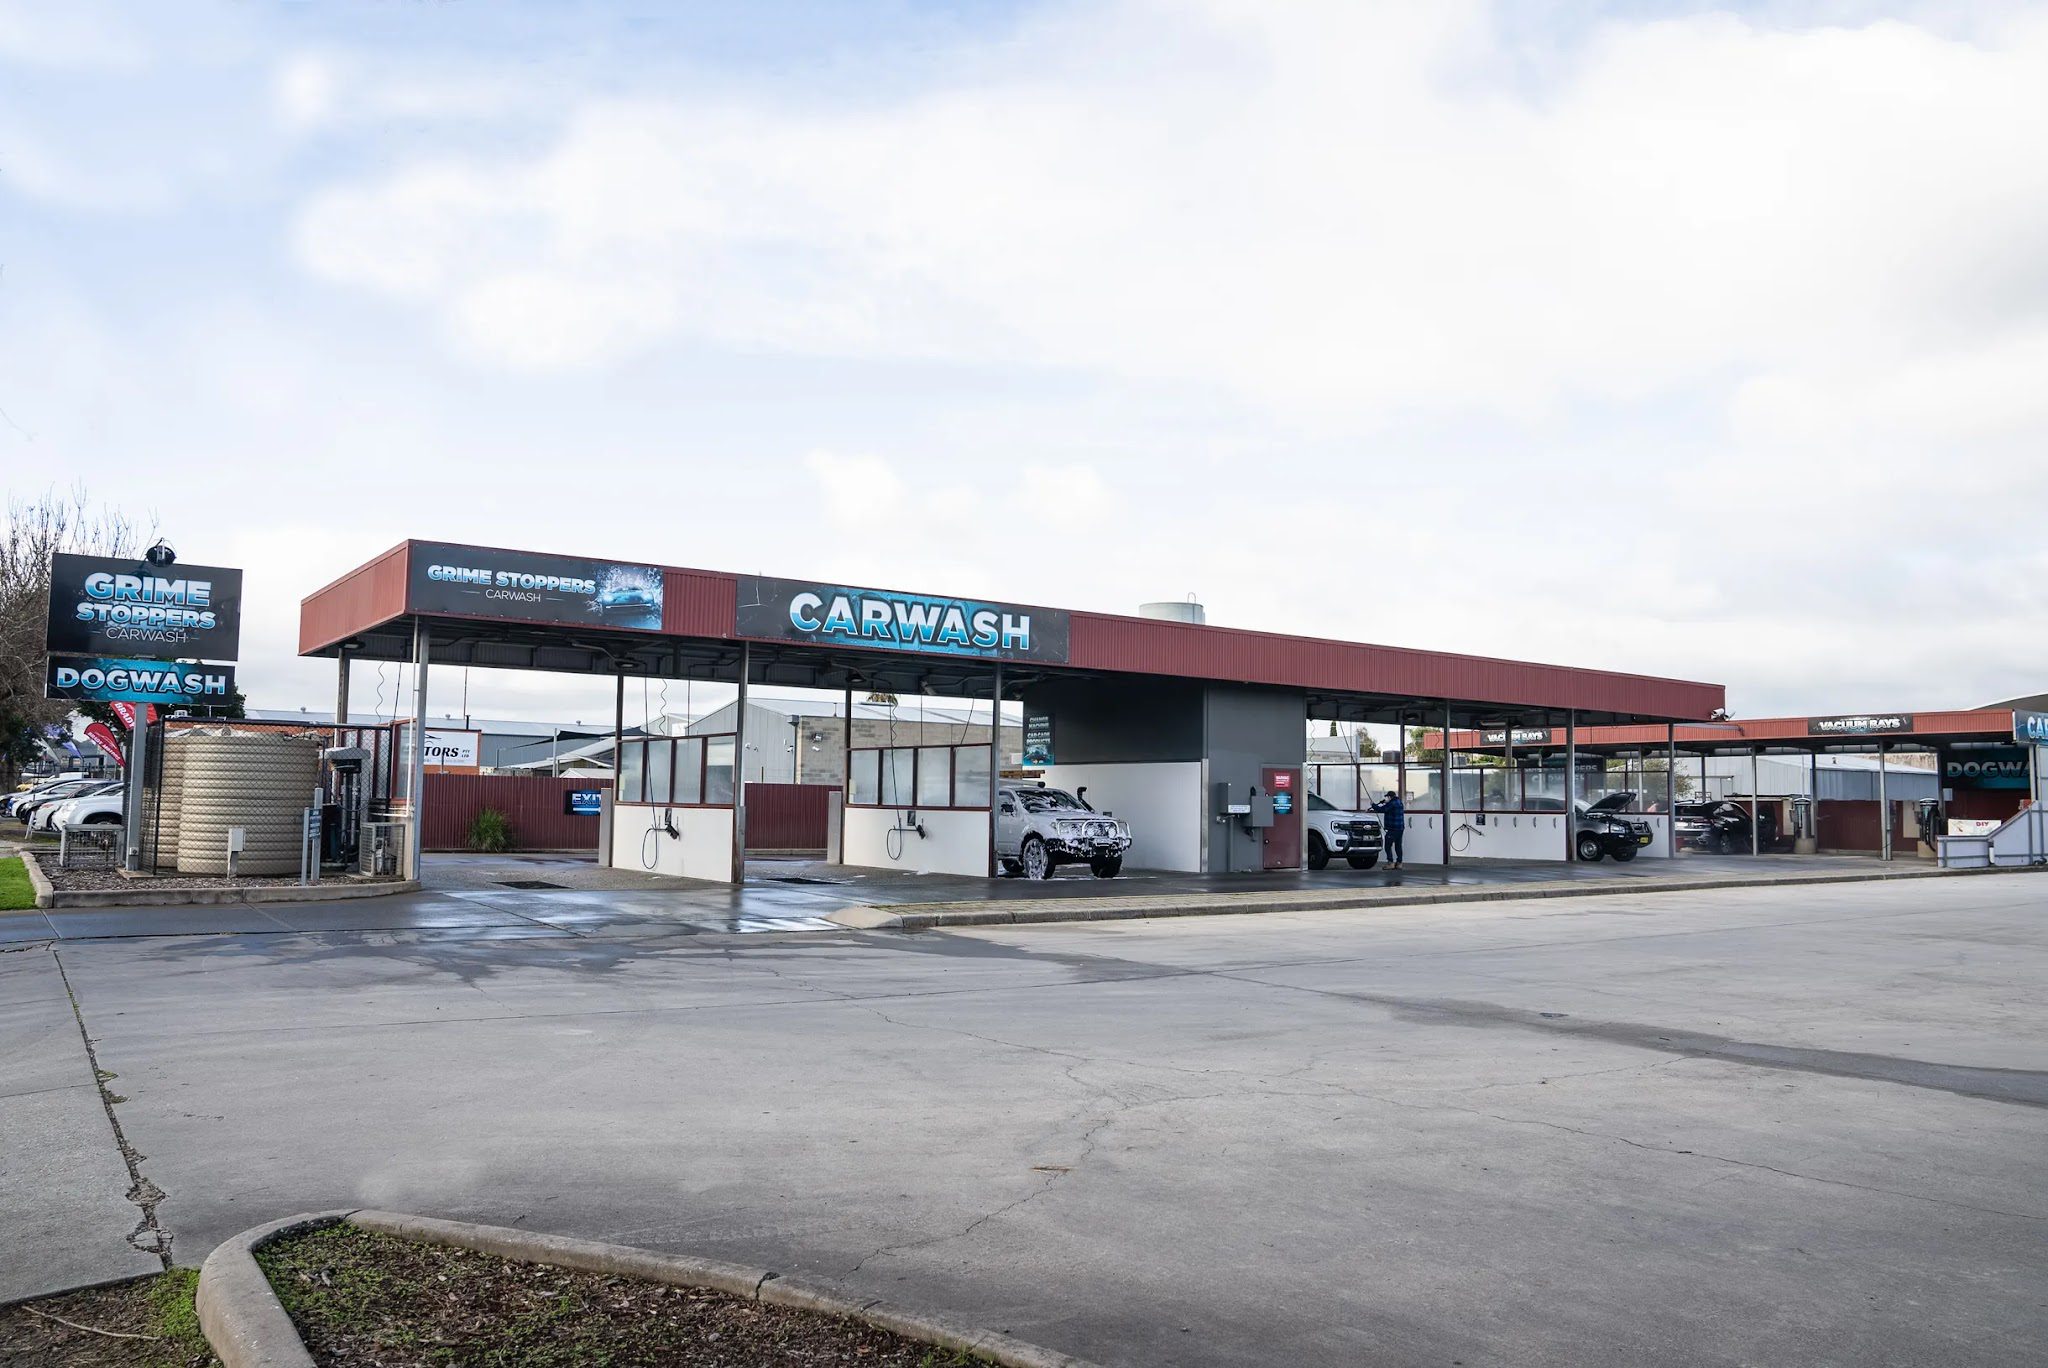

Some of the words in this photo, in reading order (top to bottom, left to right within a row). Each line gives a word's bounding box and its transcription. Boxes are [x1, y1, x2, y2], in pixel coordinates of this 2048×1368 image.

[84, 572, 212, 607] GRIME
[427, 564, 492, 585] GRIME
[496, 571, 596, 595] STOPPERS
[485, 589, 541, 603] CARWASH
[76, 602, 216, 629] STOPPERS
[789, 592, 1030, 650] CARWASH
[106, 627, 187, 643] CARWASH
[57, 667, 226, 695] DOGWASH
[1819, 720, 1868, 731] VACUUM
[1870, 718, 1901, 729] BAYS
[424, 746, 460, 758] TORS
[1946, 762, 2030, 778] DOGW
